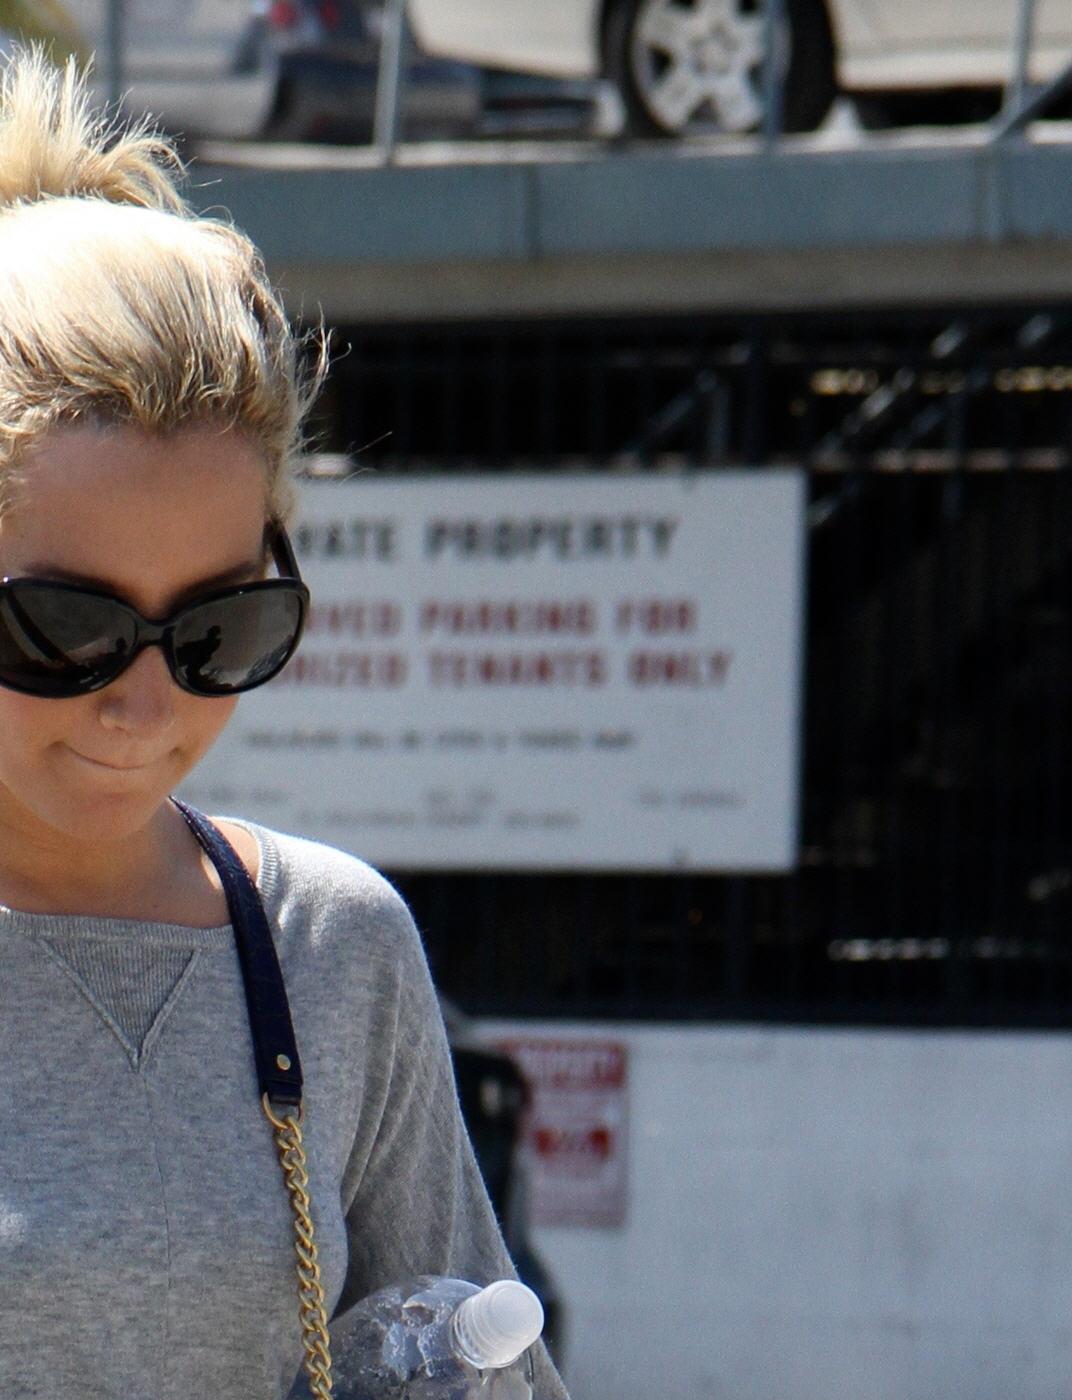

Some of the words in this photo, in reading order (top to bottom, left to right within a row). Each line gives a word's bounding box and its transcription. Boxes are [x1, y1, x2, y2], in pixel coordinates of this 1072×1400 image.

[424, 515, 680, 562] PROPERTY
[419, 599, 597, 637] PARKING
[616, 599, 699, 637] FOR
[429, 650, 607, 688] TENANTS
[628, 650, 733, 688] ONLY
